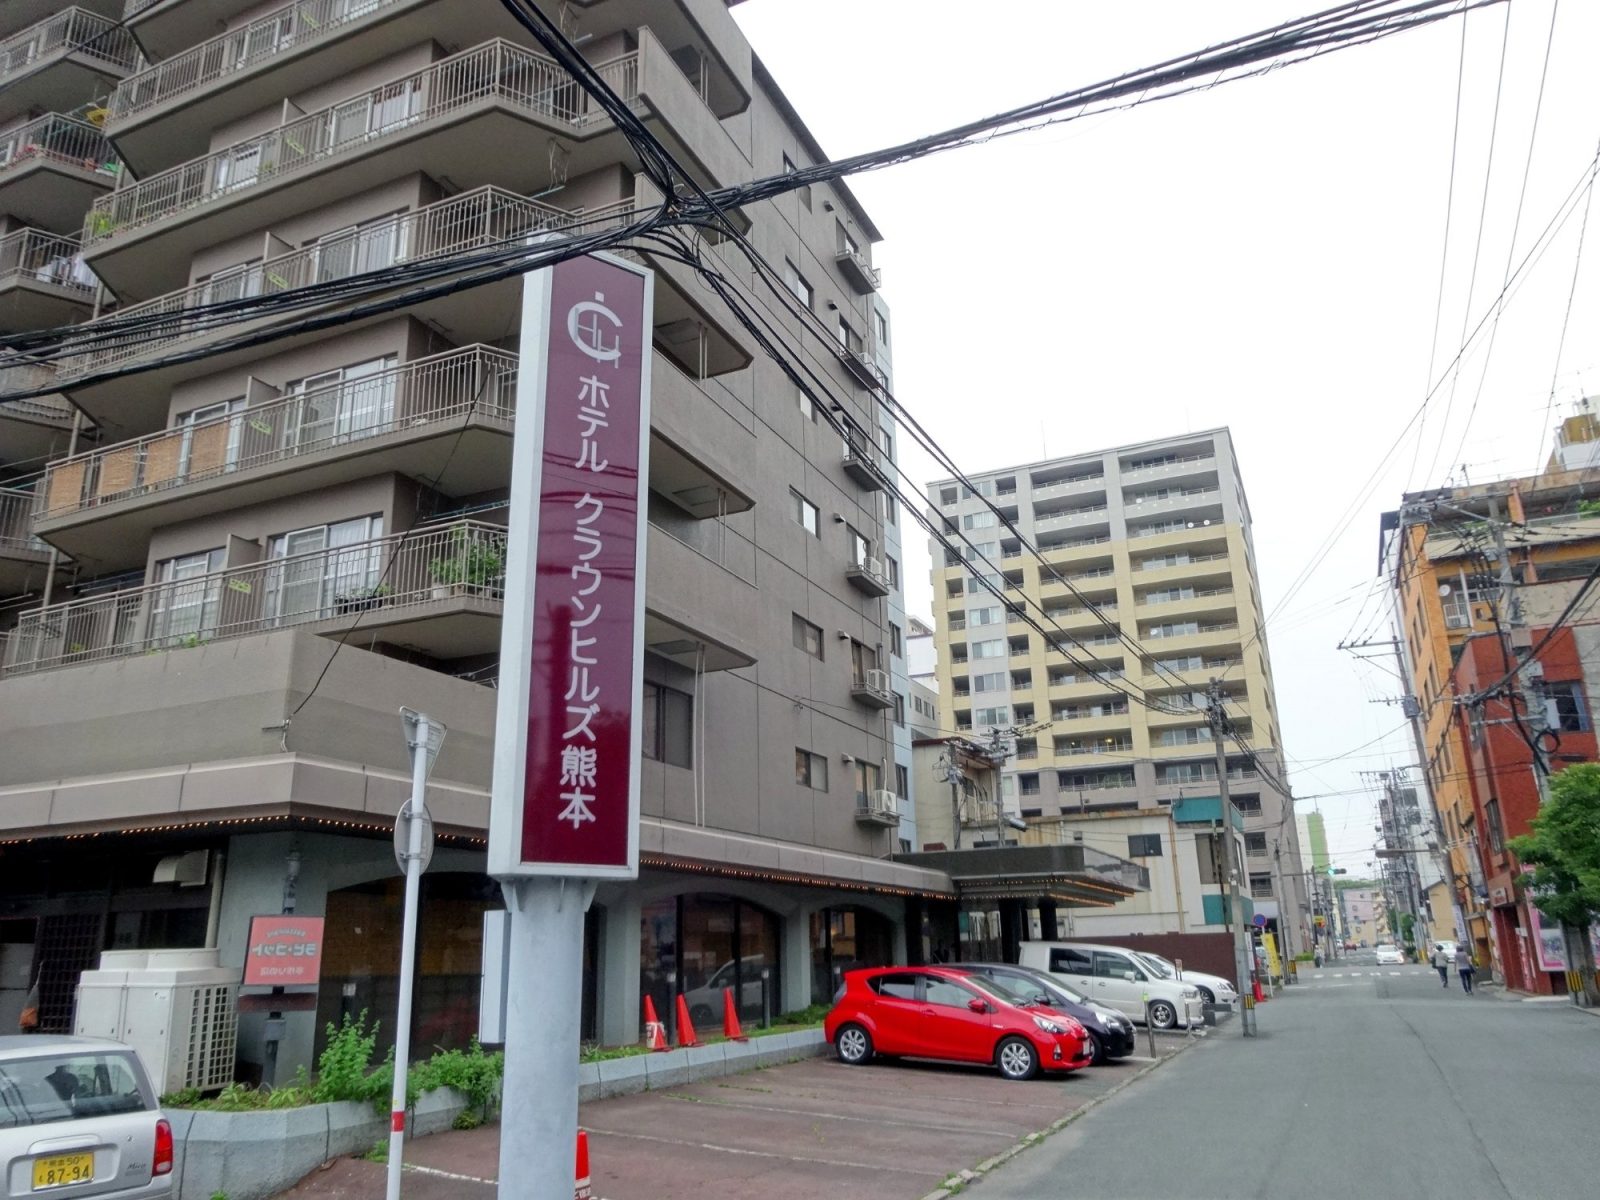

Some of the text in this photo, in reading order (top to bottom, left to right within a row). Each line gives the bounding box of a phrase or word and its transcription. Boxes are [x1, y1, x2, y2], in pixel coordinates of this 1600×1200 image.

[558, 375, 610, 829] ホテル クラウンヒルズ熊本
[47, 1164, 89, 1185] 87-94
